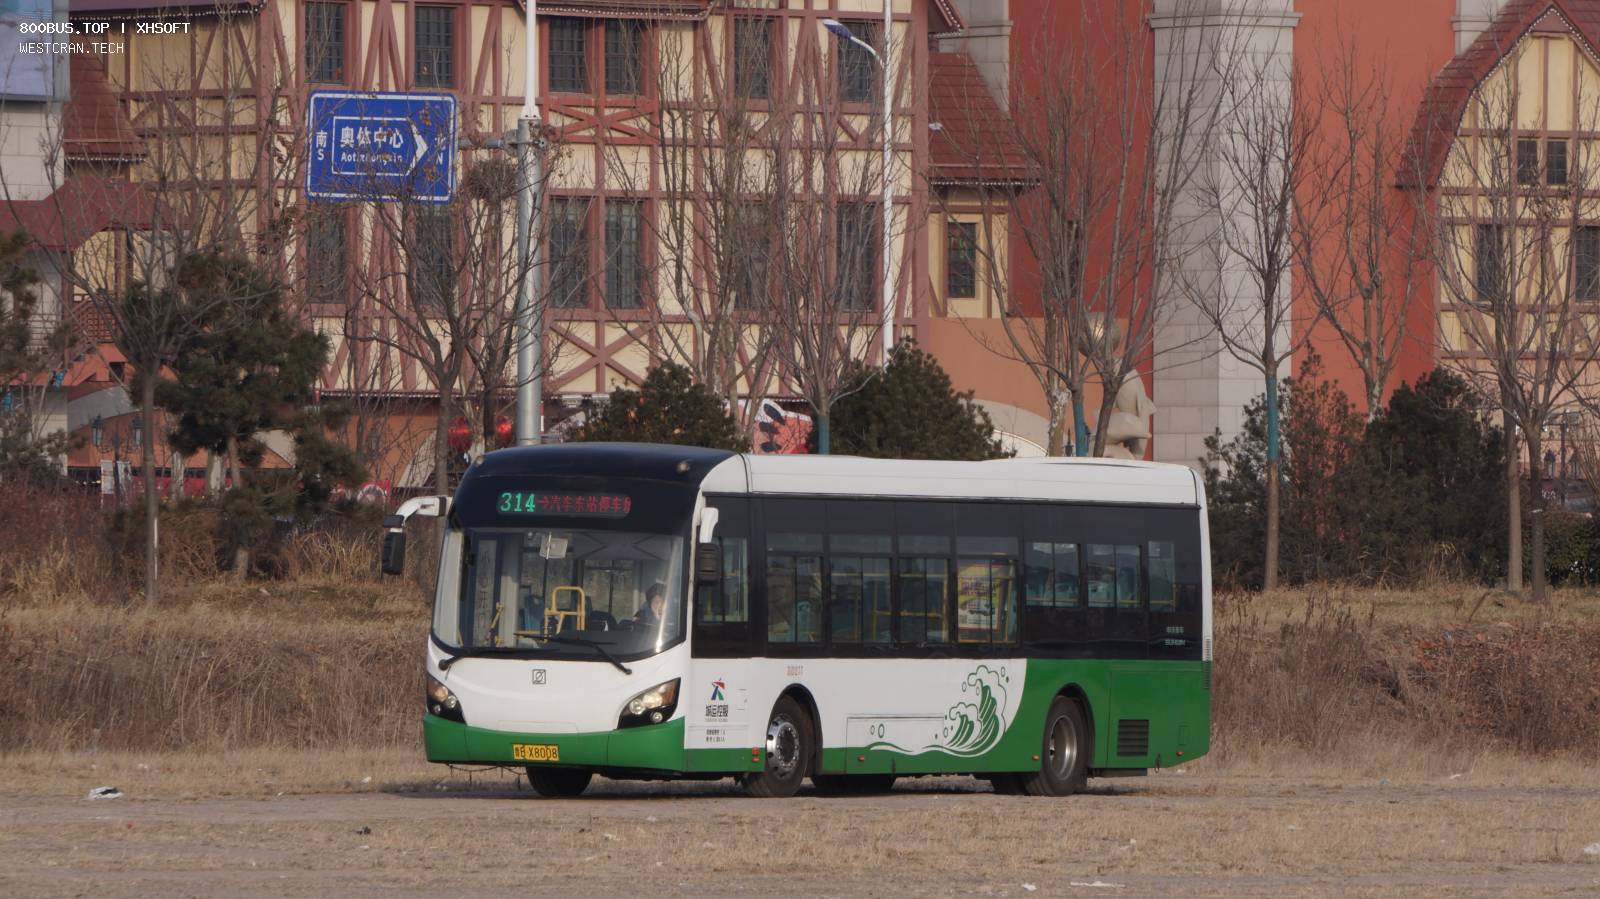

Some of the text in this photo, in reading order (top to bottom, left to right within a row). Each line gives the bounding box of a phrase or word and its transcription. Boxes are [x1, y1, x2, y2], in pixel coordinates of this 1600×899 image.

[316, 130, 327, 148] 南
[340, 126, 403, 149] 奥体中心
[317, 148, 325, 160] S
[500, 492, 536, 512] 314
